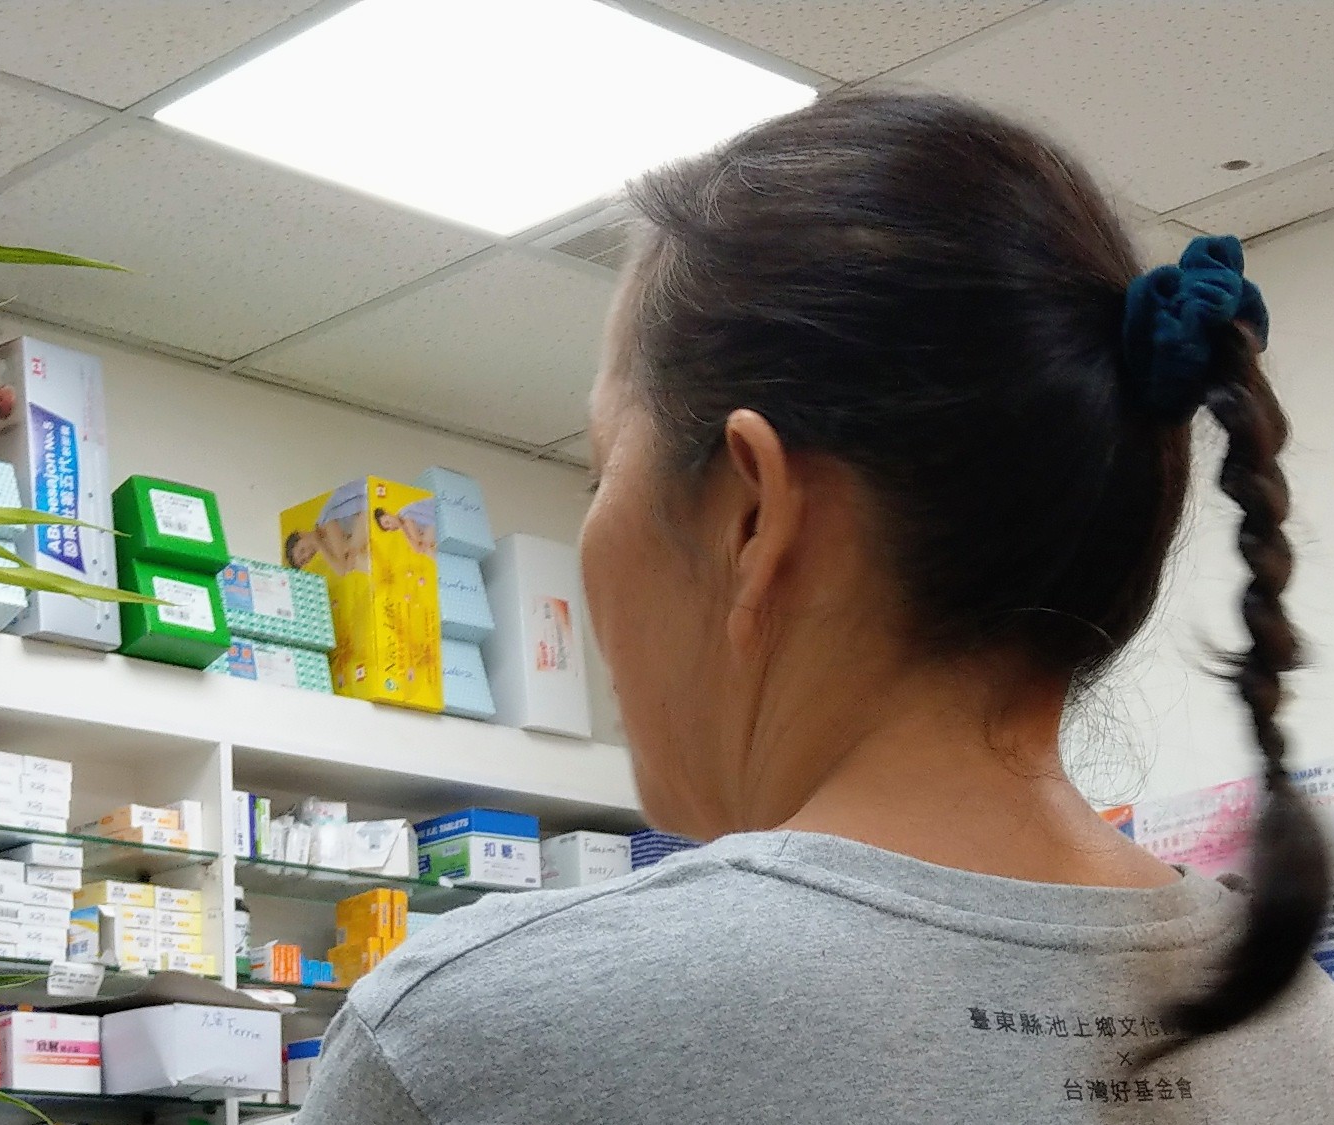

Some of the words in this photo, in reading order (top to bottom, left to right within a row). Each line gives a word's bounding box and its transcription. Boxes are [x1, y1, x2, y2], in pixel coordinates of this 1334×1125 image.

[967, 1006, 1175, 1038] 臺東縣池上鄉文化
[1063, 1076, 1193, 1103] 台灣好基金會
